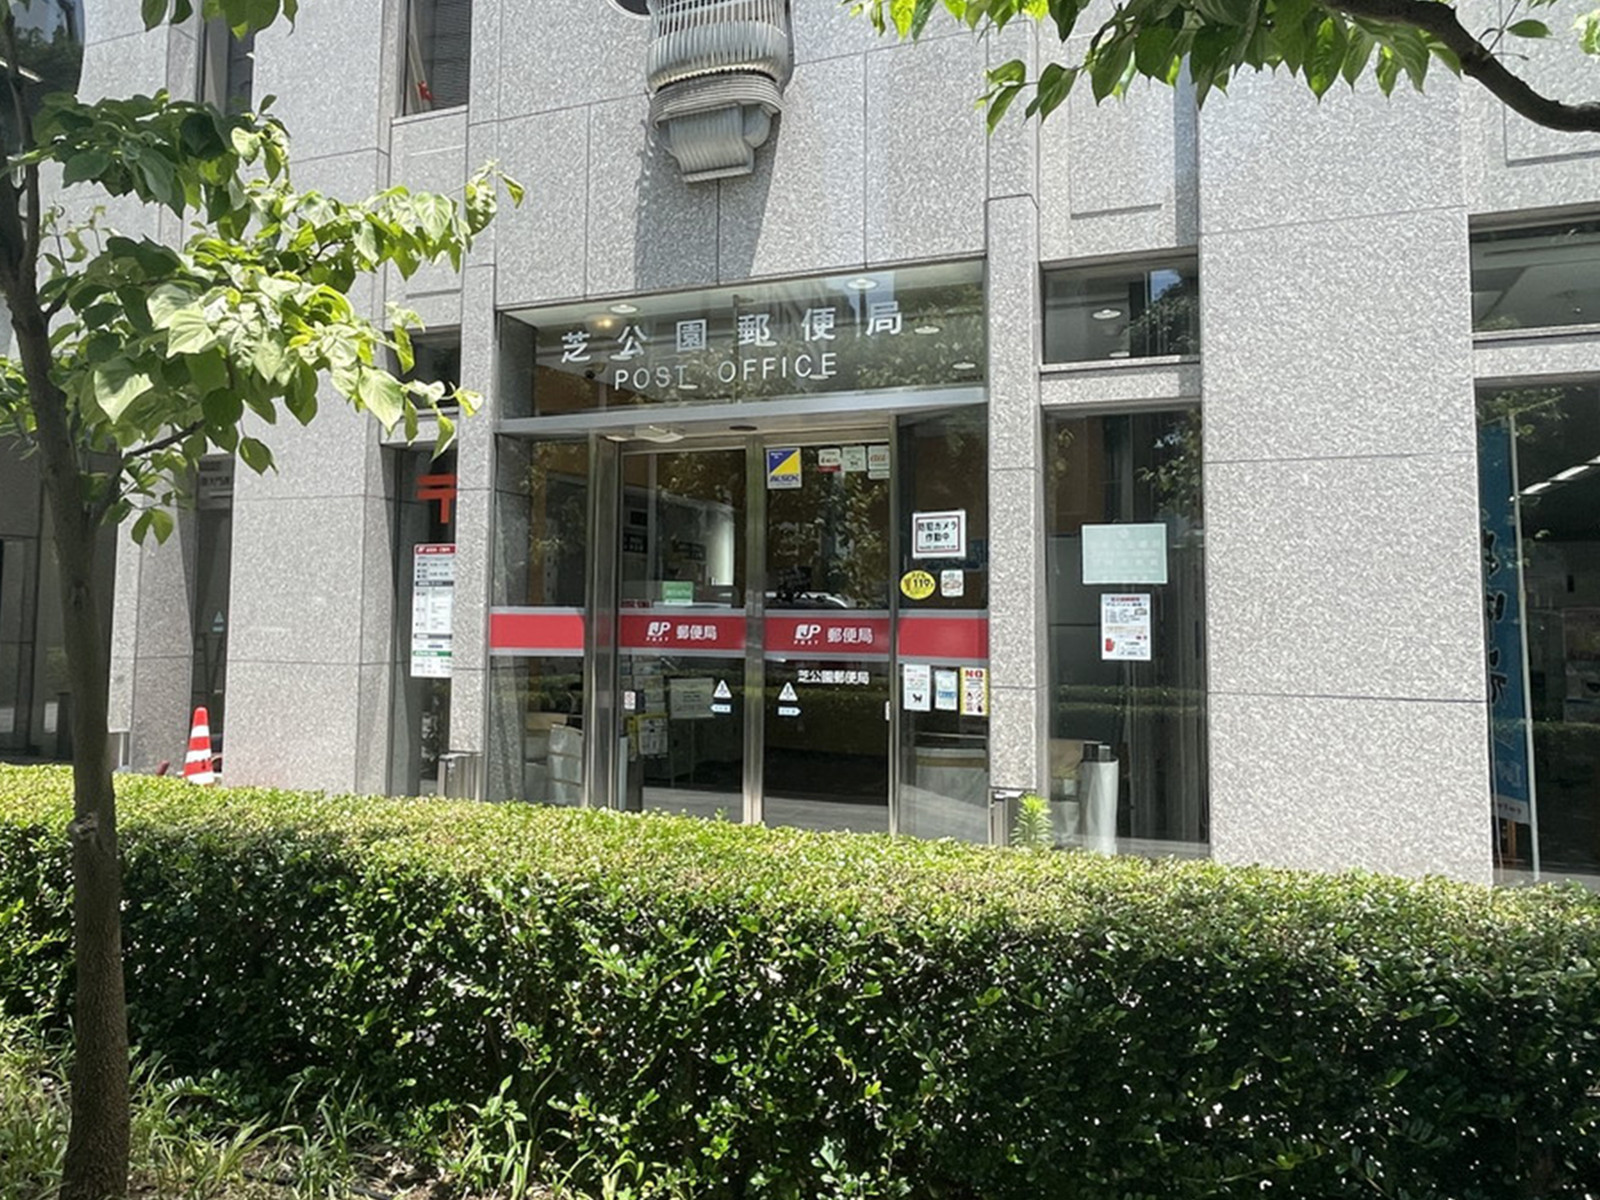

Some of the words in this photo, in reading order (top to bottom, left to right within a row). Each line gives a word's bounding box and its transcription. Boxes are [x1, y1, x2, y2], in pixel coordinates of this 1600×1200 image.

[561, 300, 903, 364] 芝公園郵便局
[614, 363, 689, 391] POST
[717, 352, 838, 384] OFFICE
[676, 625, 717, 641] 郵便局
[827, 627, 873, 644] 郵便局
[797, 670, 869, 685] 芝公園郵便局
